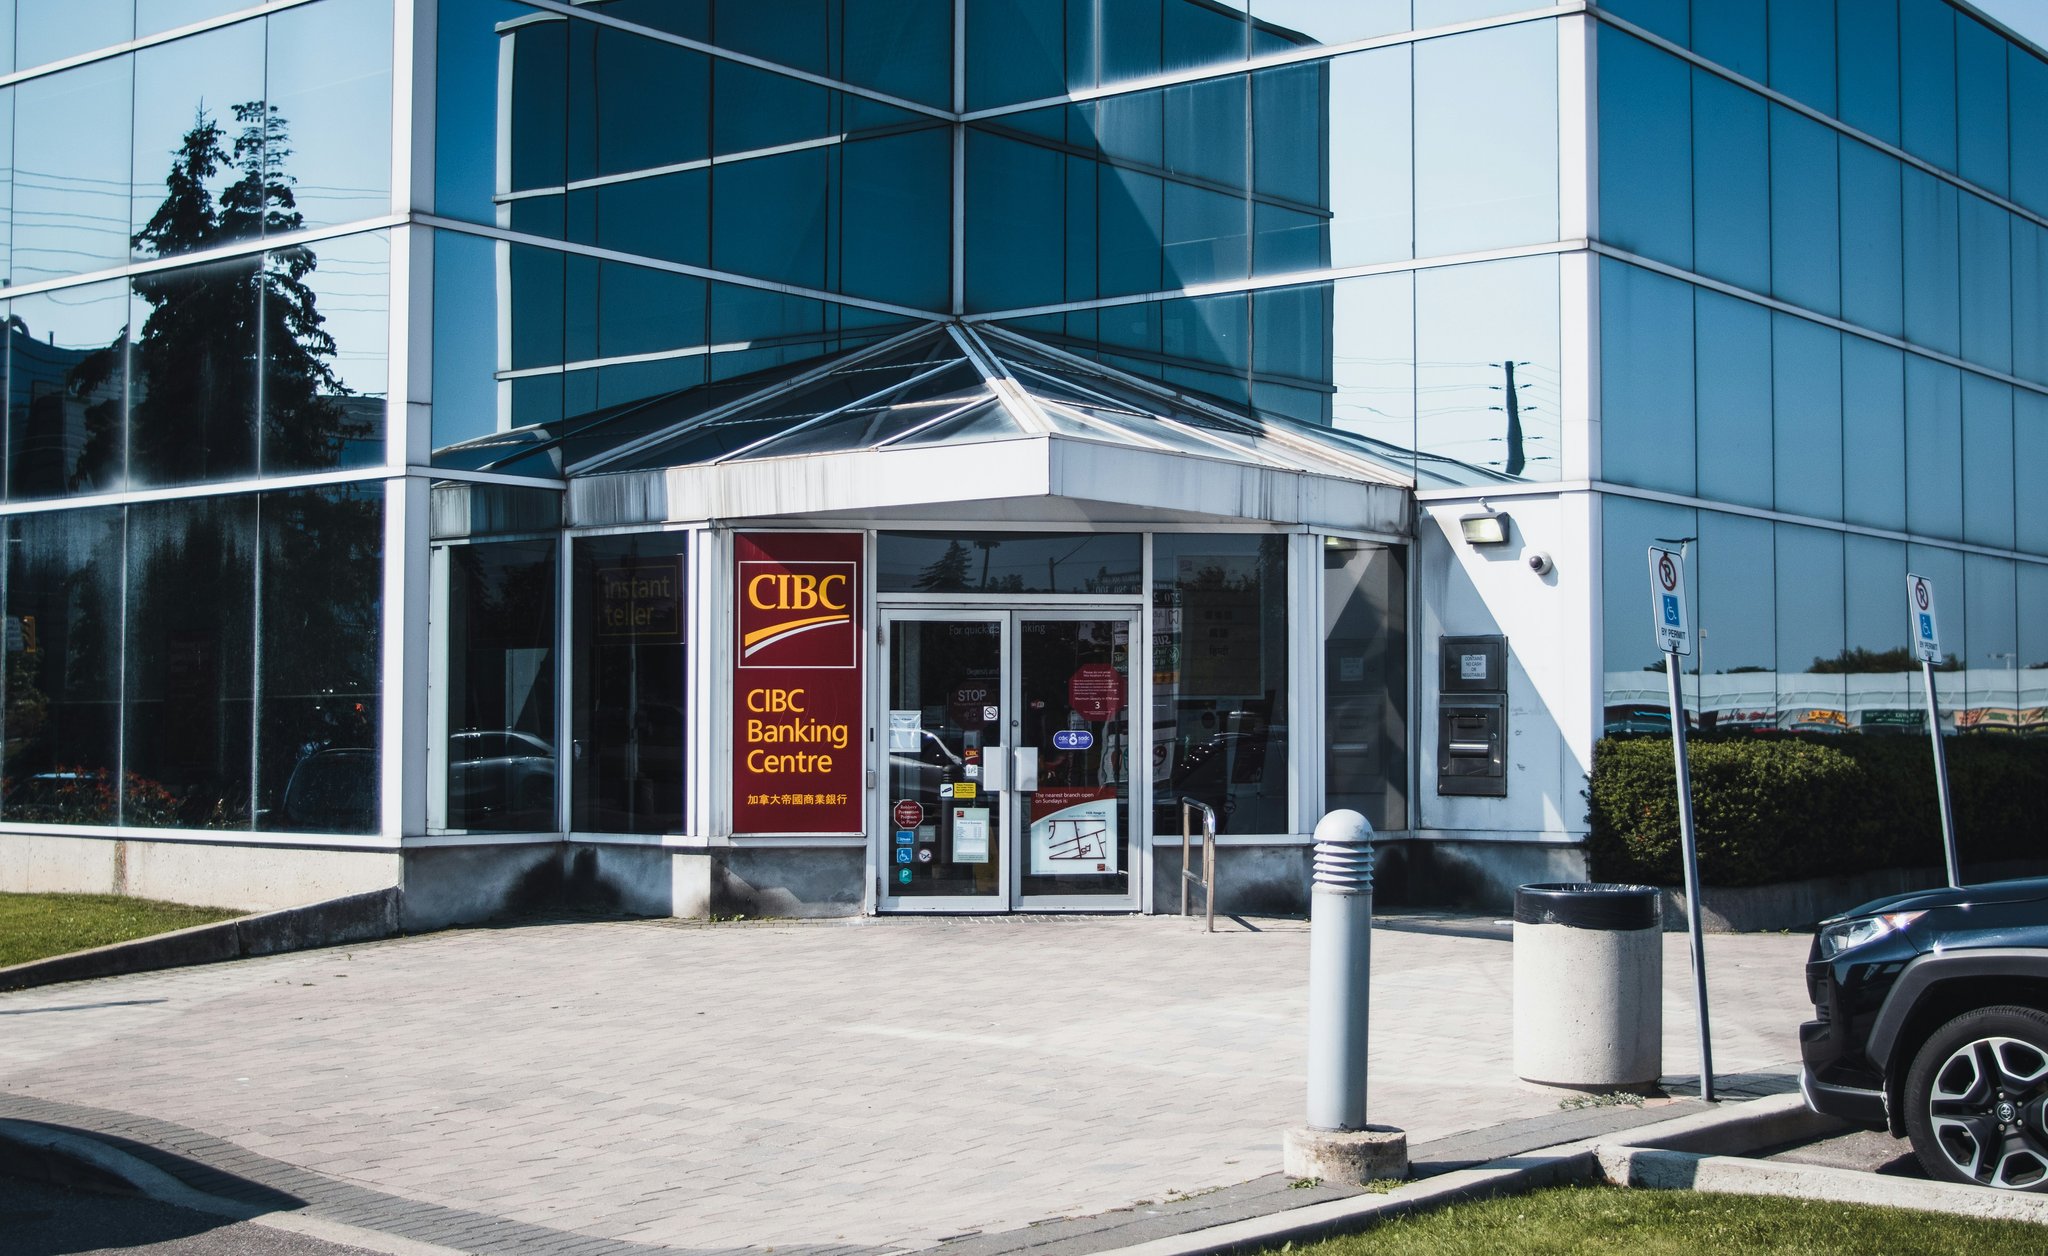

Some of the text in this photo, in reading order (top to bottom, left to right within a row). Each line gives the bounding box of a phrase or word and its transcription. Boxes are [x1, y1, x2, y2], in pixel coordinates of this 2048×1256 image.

[604, 574, 670, 599] instant
[748, 573, 846, 611] CIBC
[605, 601, 654, 626] teller
[949, 625, 962, 635] For
[964, 624, 986, 637] quick
[1022, 624, 1046, 635] nking
[1661, 627, 1685, 639] BY PERMIT
[1668, 639, 1681, 648] ONLY
[747, 688, 805, 713] CIBC
[958, 689, 987, 702] STOP
[1094, 701, 1101, 710] 3
[747, 718, 848, 750] Banking
[747, 749, 833, 774] Centre
[747, 793, 847, 806] 加拿大帝國商業銀行
